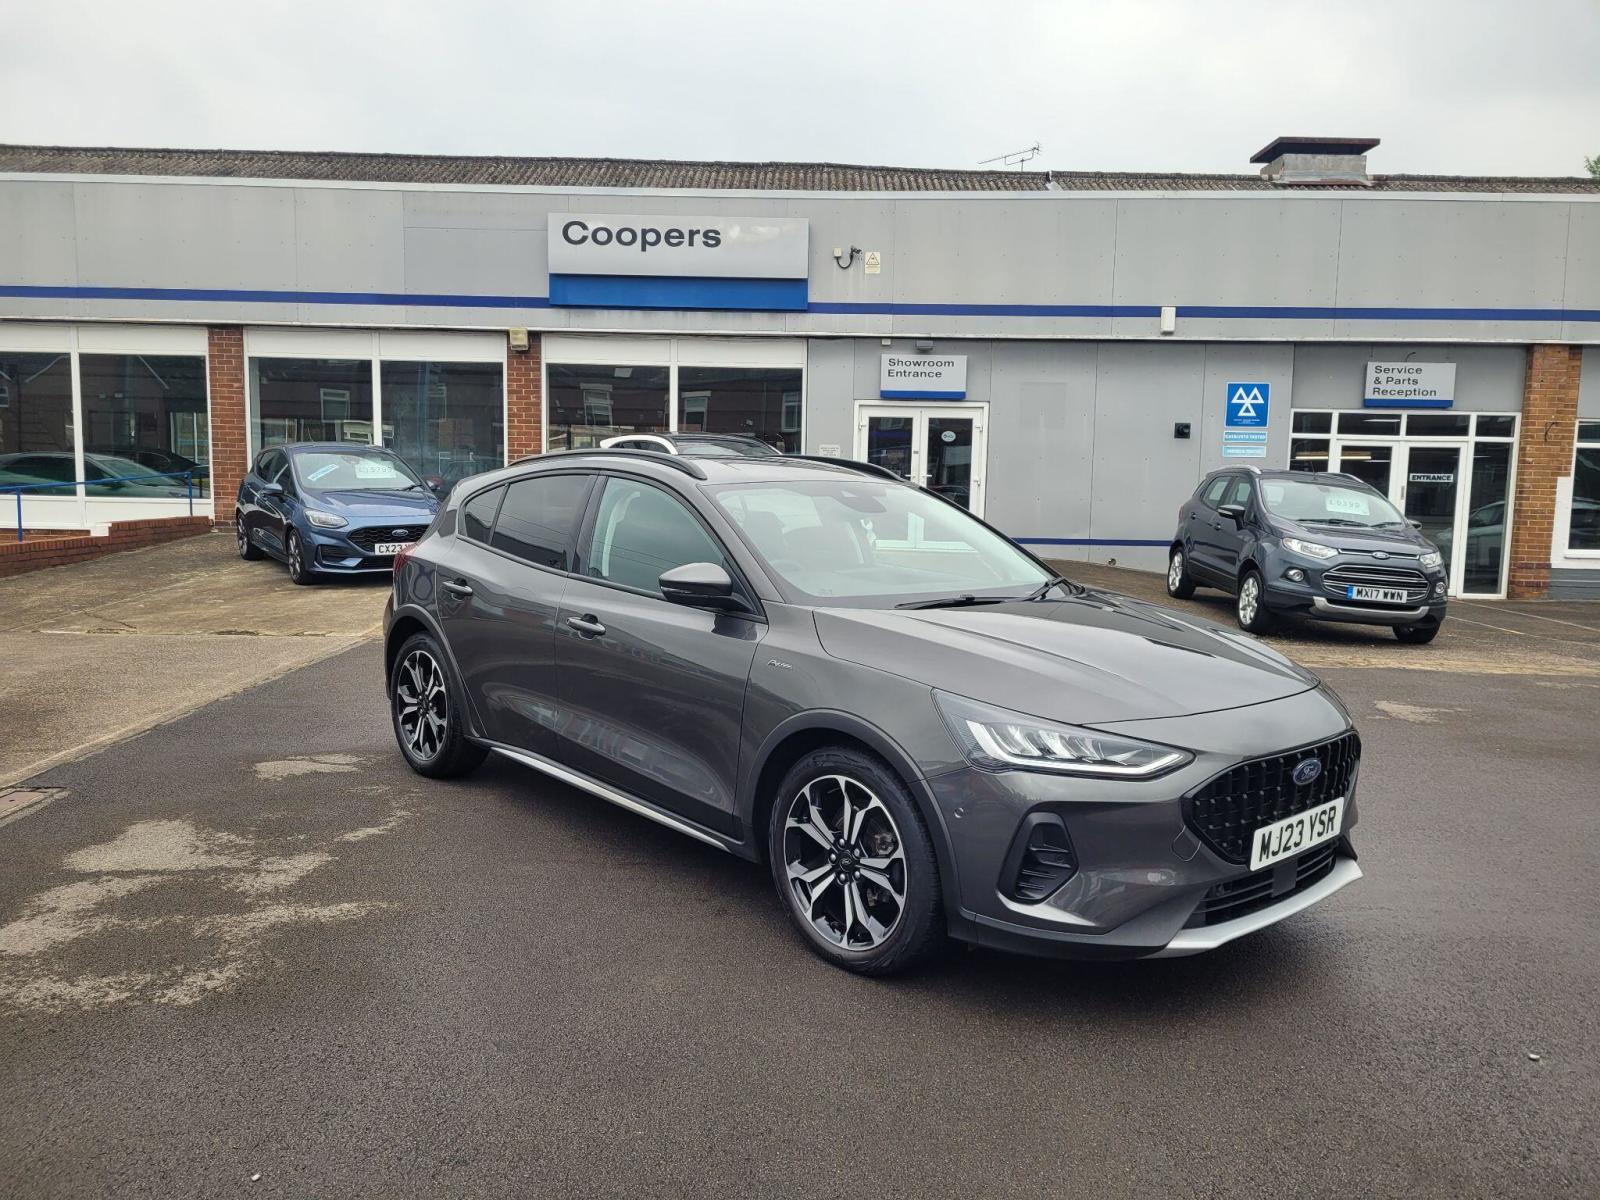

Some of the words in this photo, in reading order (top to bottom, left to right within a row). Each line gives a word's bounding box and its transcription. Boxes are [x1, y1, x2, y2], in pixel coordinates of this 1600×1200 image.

[562, 220, 722, 252] Coopers
[888, 358, 955, 367] Showroom
[887, 369, 942, 378] Entrance
[1374, 365, 1423, 375] Service
[1373, 376, 1382, 385] &
[1385, 376, 1419, 385] Parts
[1372, 387, 1437, 397] Reception
[378, 544, 403, 554] CX23
[1356, 587, 1380, 598] MX17
[1383, 590, 1404, 601] WWN
[1259, 819, 1304, 862] MJ23
[1309, 805, 1337, 842] YSR
